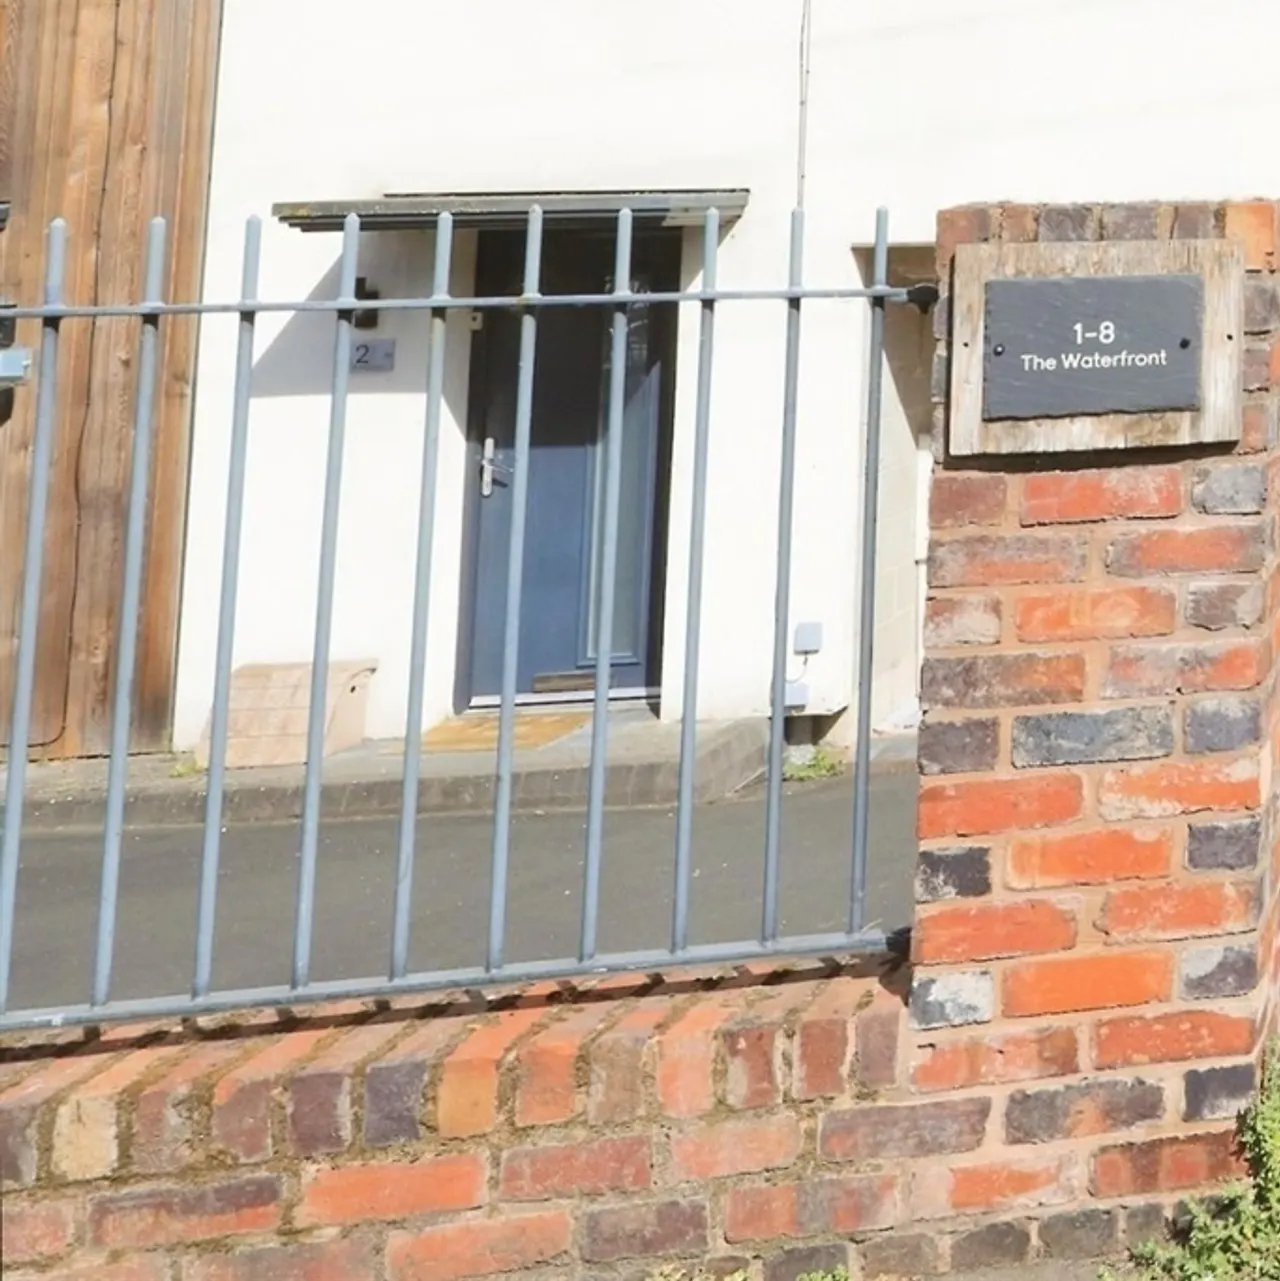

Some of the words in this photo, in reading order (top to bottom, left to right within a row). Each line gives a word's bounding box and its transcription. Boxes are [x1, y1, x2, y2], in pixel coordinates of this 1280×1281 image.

[1073, 320, 1115, 345] 1-8
[355, 344, 370, 364] 2
[1020, 354, 1057, 371] The
[1061, 349, 1167, 369] Waterfront
